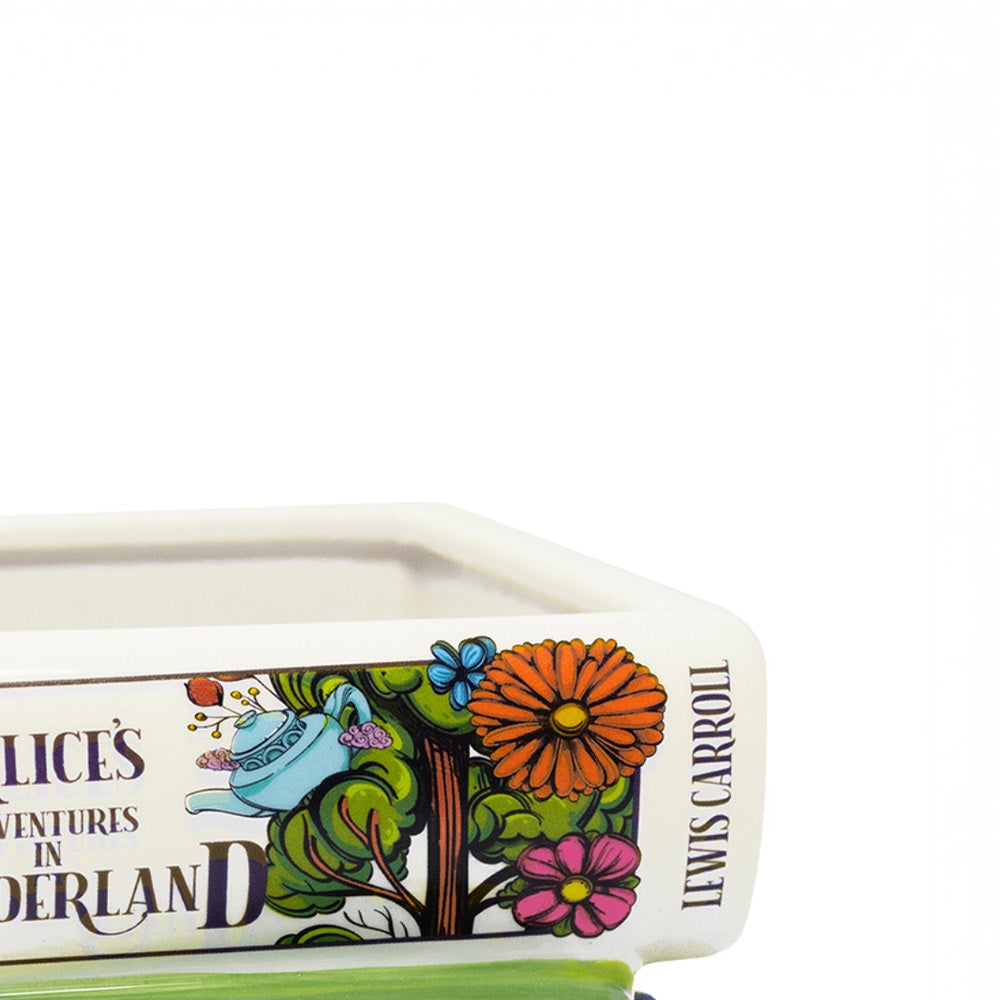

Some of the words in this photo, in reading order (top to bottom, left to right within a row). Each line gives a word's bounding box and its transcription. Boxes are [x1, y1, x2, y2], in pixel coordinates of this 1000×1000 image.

[689, 659, 736, 807] CARROLL
[33, 841, 61, 867] IN
[681, 814, 730, 911] LEWIS
